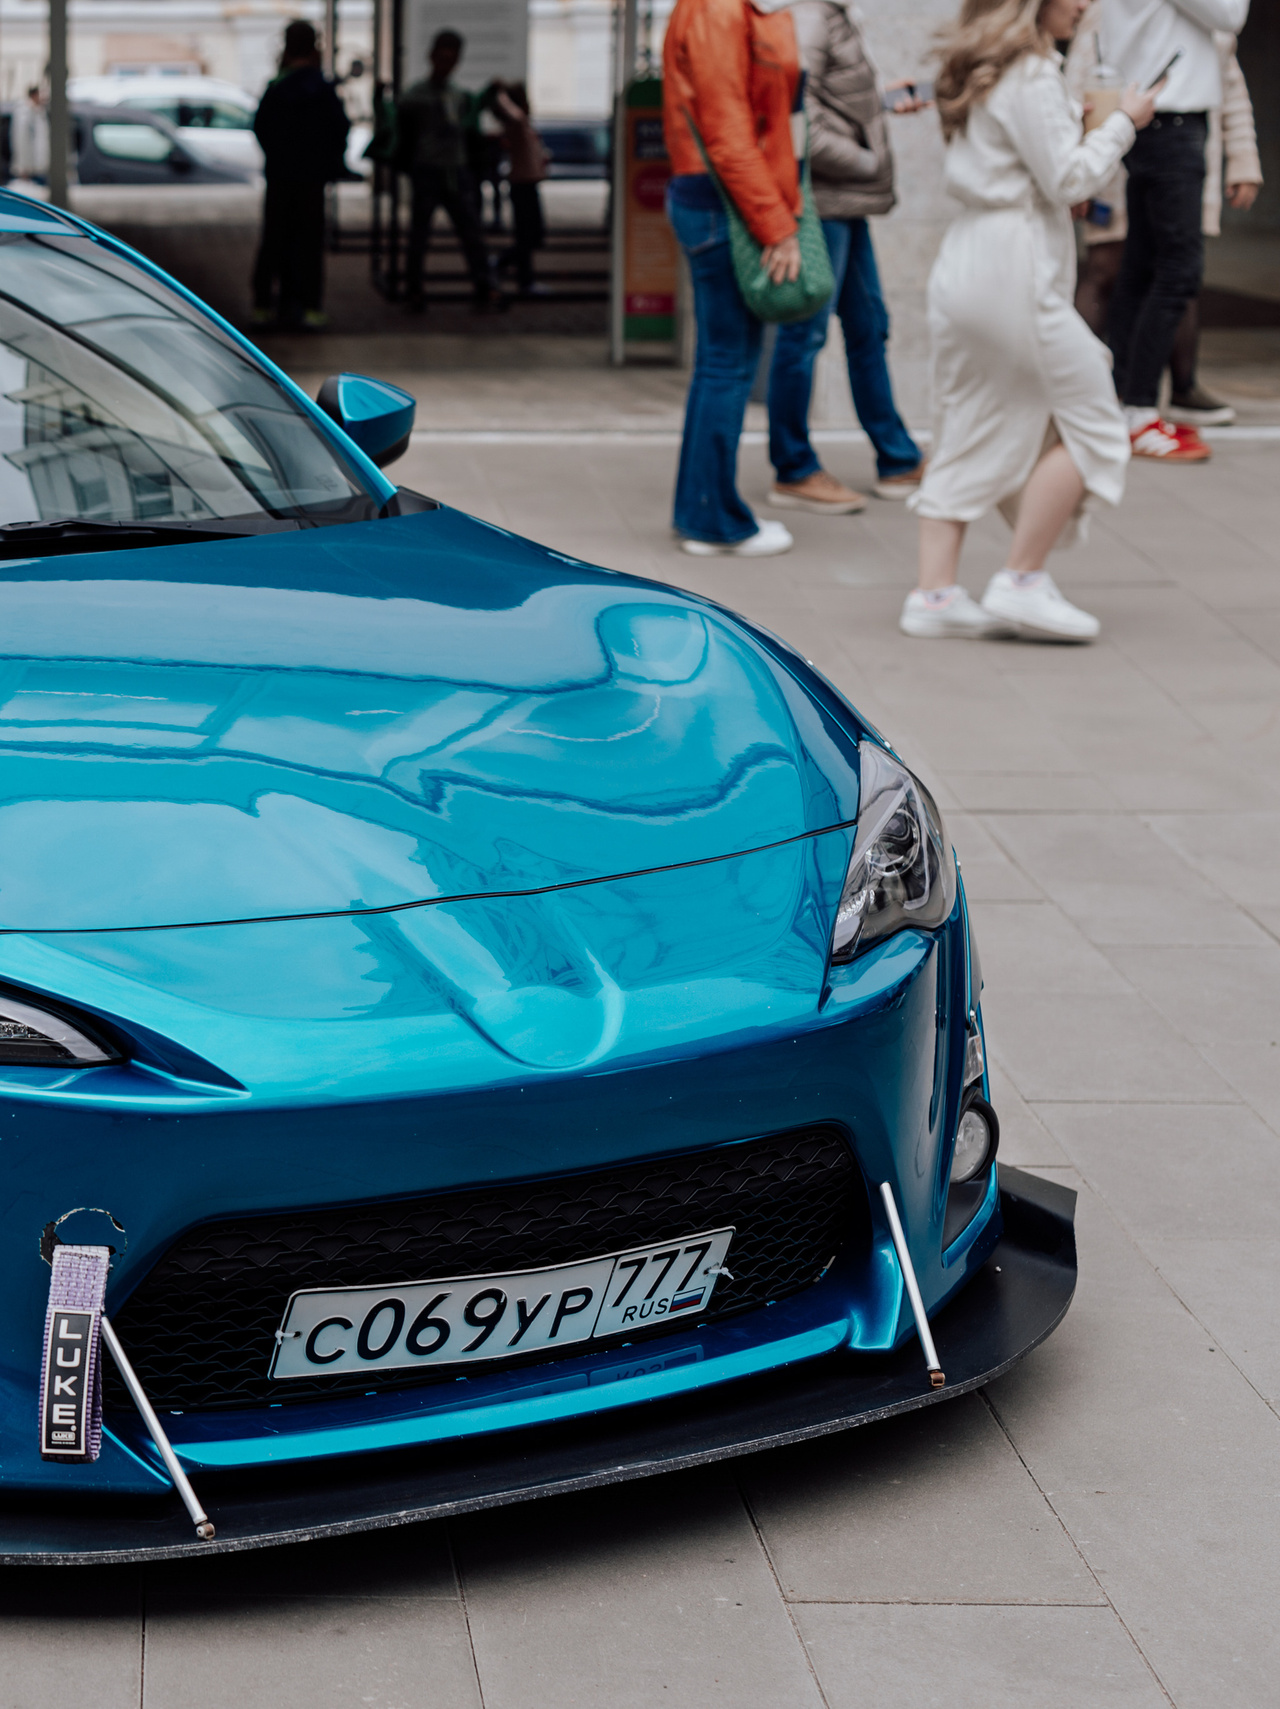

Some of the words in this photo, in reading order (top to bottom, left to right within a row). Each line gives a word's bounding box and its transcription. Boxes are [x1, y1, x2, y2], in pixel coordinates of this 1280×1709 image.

[305, 1286, 594, 1365] С069УР
[612, 1241, 712, 1307] 777
[622, 1298, 670, 1324] RUS
